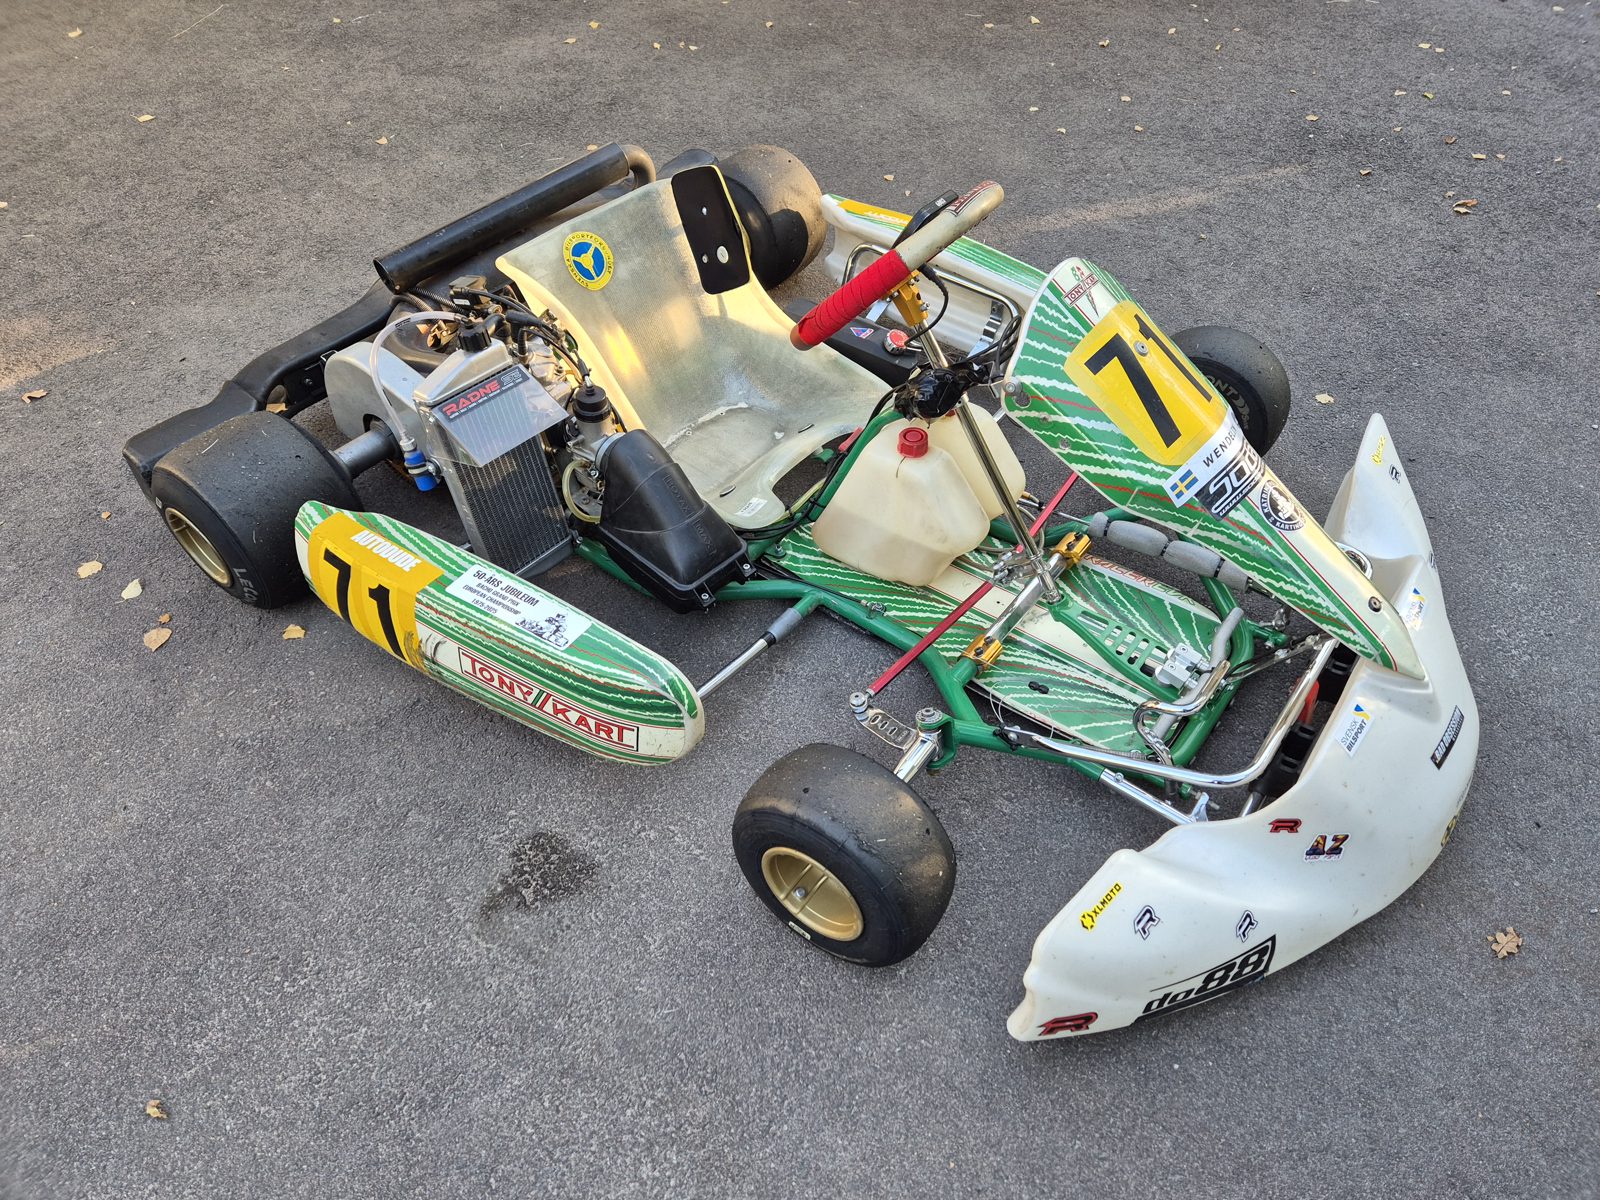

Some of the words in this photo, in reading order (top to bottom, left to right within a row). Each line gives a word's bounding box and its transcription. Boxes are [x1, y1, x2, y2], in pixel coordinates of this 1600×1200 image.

[442, 379, 502, 417] RADNE
[1083, 313, 1213, 450] 71
[350, 529, 423, 573] AUTODUDE
[323, 547, 408, 662] 71
[462, 584, 487, 599] EUROPEAN
[485, 595, 522, 615] CHAMPIONSHIP
[473, 569, 503, 588] 50-ÅRS
[500, 584, 540, 607] JUBILEUM
[491, 590, 509, 601] GRAND
[508, 598, 521, 607] PRIX
[462, 652, 534, 702] TONY
[552, 697, 635, 743] KART
[1340, 718, 1360, 746] SVENSK
[1345, 718, 1367, 752] BILSPORT
[1091, 883, 1123, 918] XLMOTO
[1142, 944, 1271, 1014] do88
